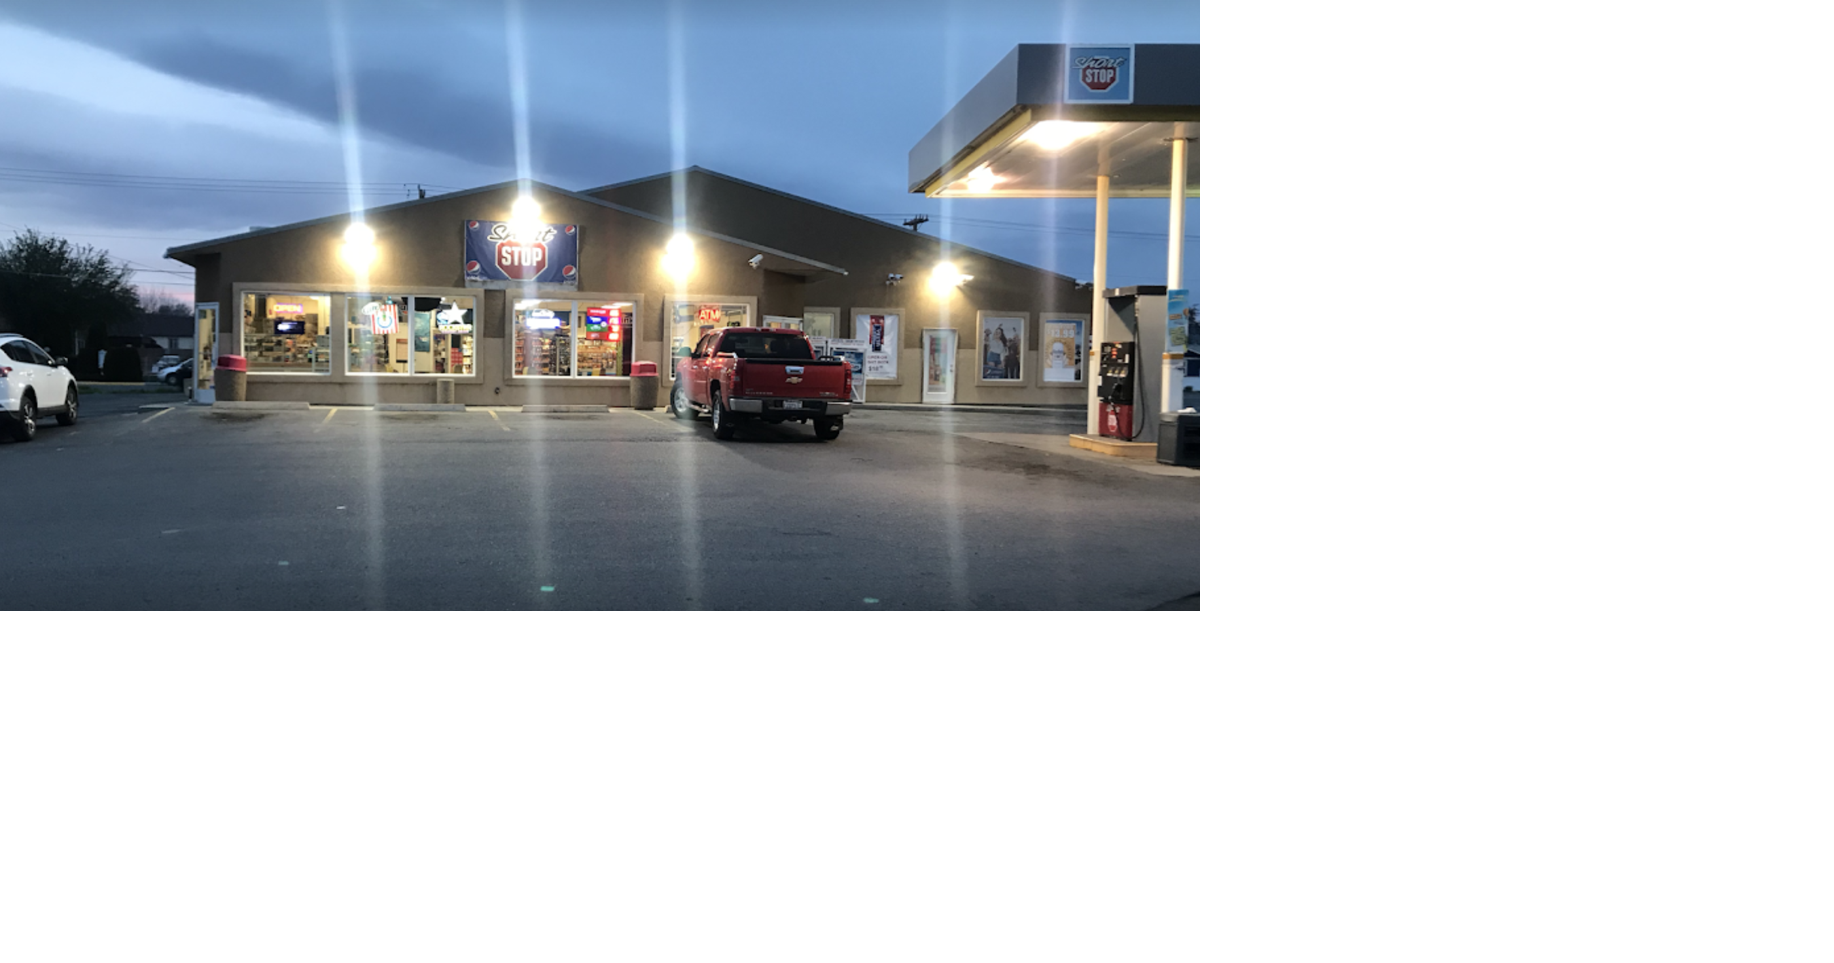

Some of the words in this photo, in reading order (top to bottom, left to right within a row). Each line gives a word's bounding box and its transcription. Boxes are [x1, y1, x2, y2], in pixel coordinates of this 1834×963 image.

[1072, 55, 1126, 69] Short
[1085, 69, 1114, 83] STOP
[501, 246, 543, 267] STOP
[700, 309, 720, 320] ATM
